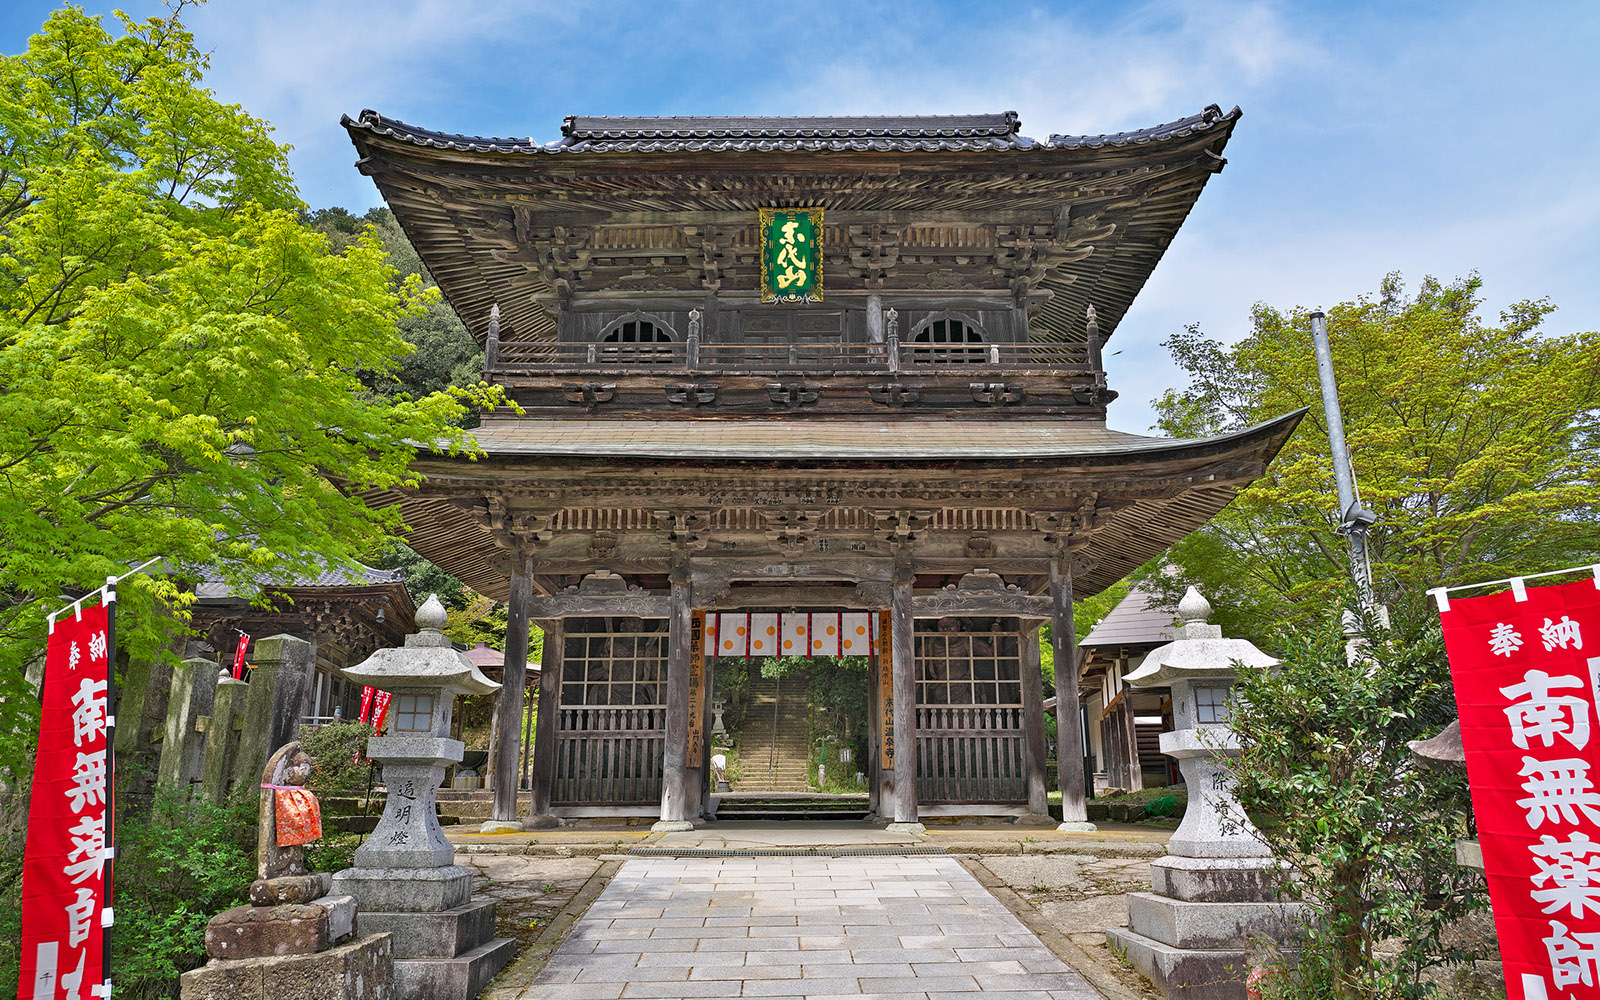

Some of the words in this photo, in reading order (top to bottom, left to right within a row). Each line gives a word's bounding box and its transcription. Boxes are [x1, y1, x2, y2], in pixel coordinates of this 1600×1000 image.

[776, 221, 807, 289] 末代山
[69, 630, 108, 671] 奉納
[1488, 615, 1583, 658] 奉納
